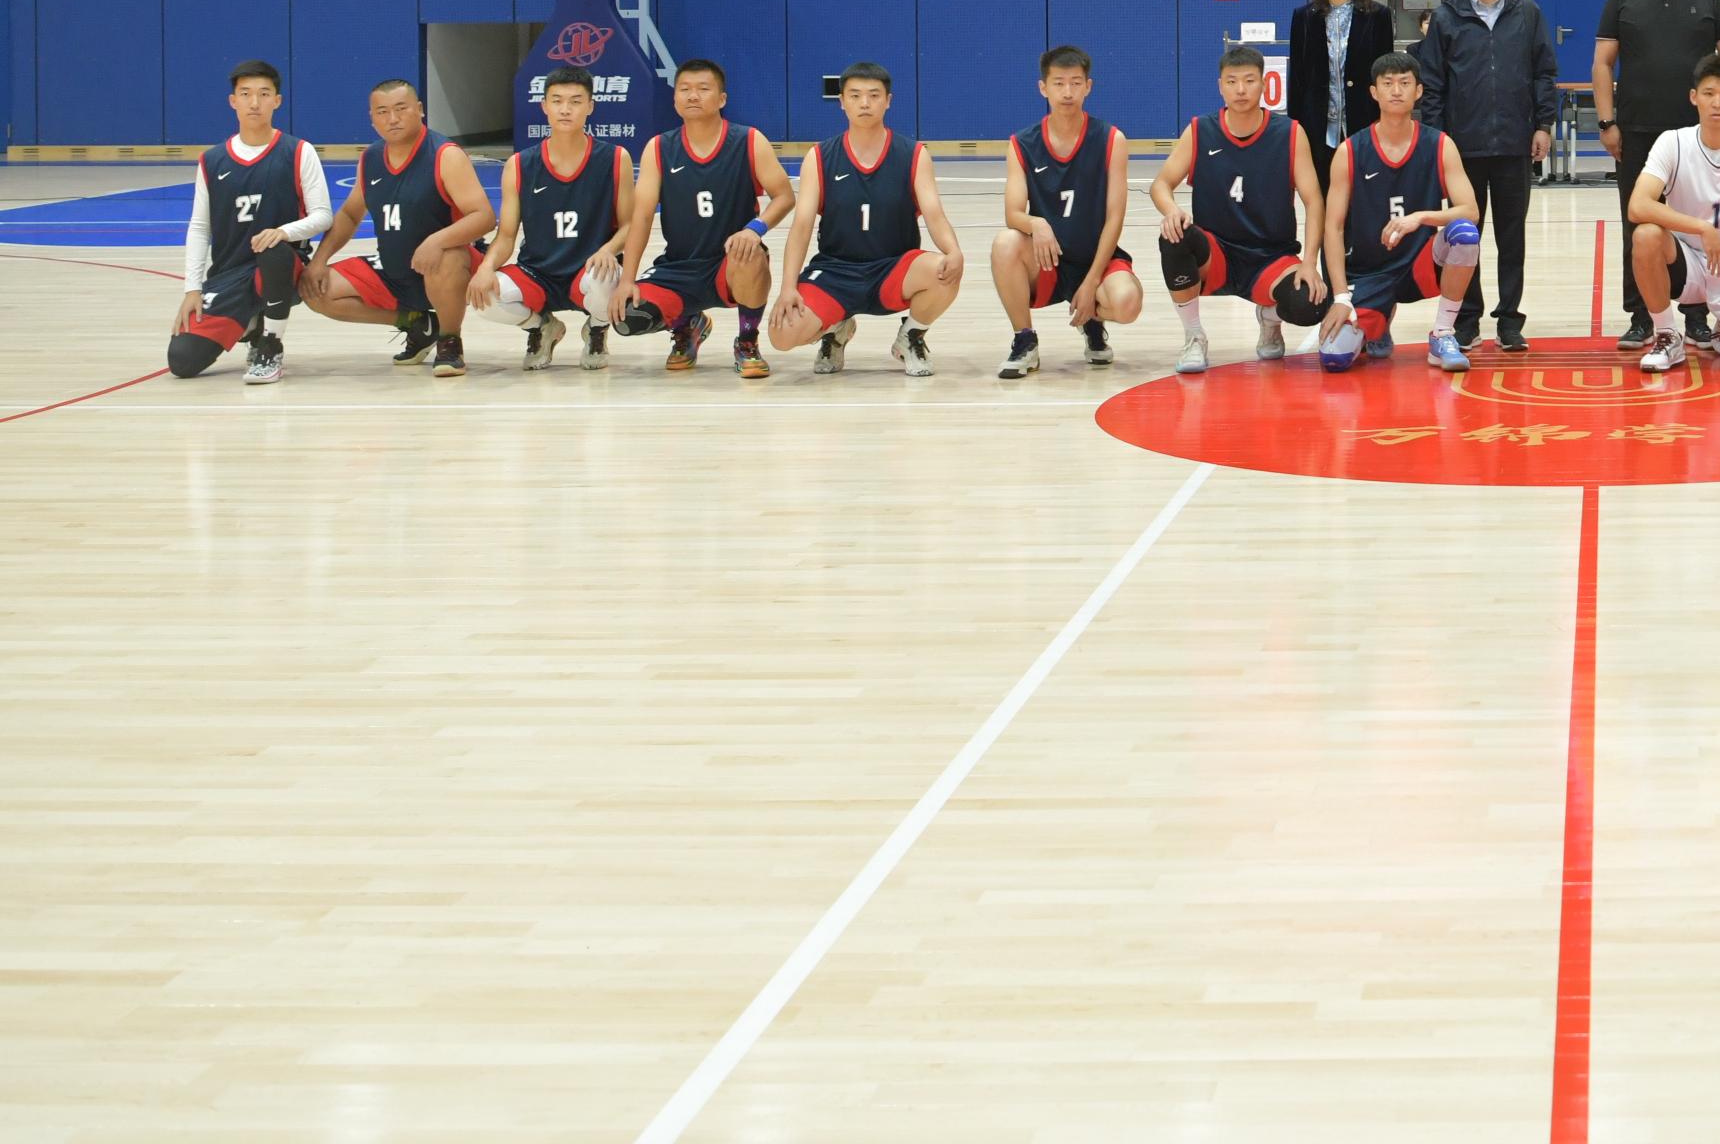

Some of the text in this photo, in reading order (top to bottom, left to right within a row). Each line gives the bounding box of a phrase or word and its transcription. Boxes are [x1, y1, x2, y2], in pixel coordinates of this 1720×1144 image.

[528, 125, 635, 138] 国际认证器材
[1060, 189, 1075, 218] 7
[1229, 176, 1244, 203] 4
[235, 193, 262, 223] 27
[382, 203, 401, 231] 14
[696, 190, 714, 218] 6
[861, 203, 870, 231] 1
[1389, 196, 1405, 220] 5
[553, 210, 578, 239] 12
